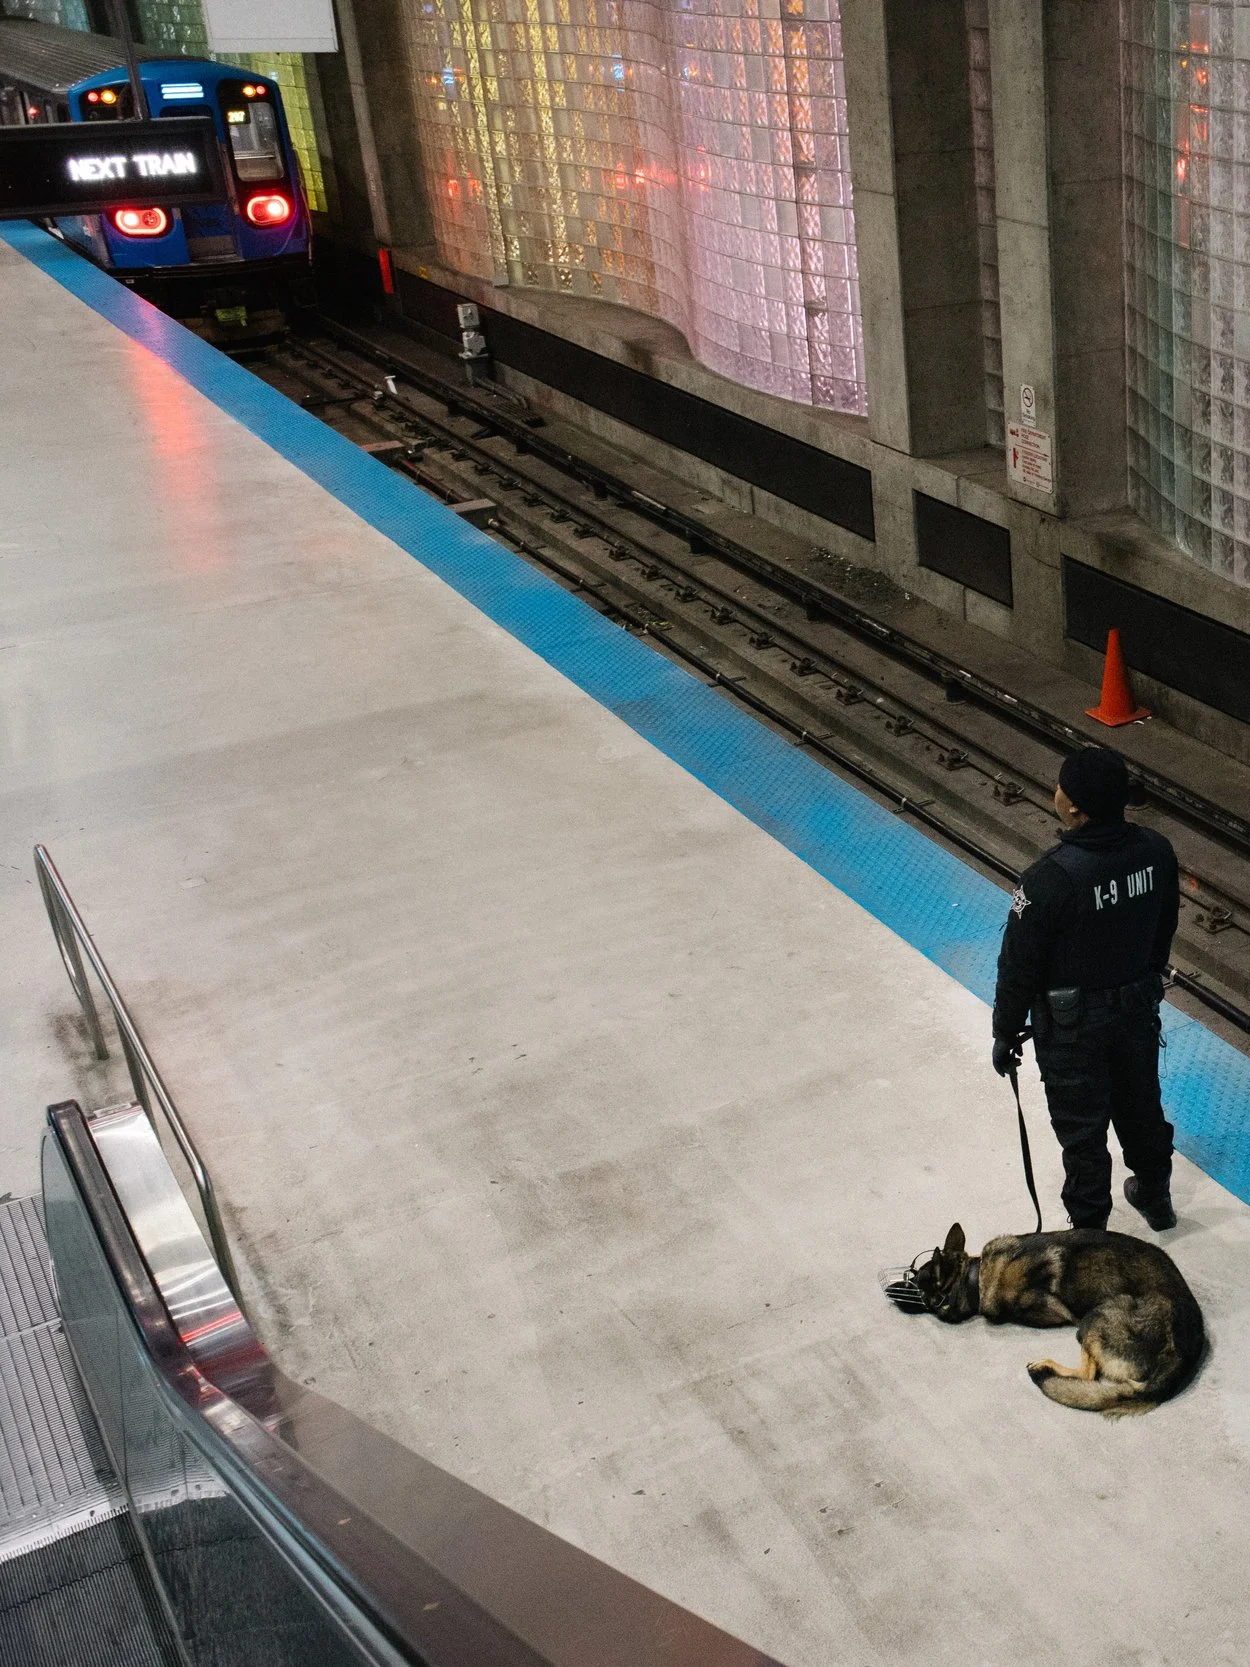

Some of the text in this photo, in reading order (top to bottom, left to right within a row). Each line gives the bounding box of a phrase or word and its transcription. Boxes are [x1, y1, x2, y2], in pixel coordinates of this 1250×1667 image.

[69, 152, 197, 181] NEXT TRAIN
[1094, 866, 1153, 911] K-9 UNIT
